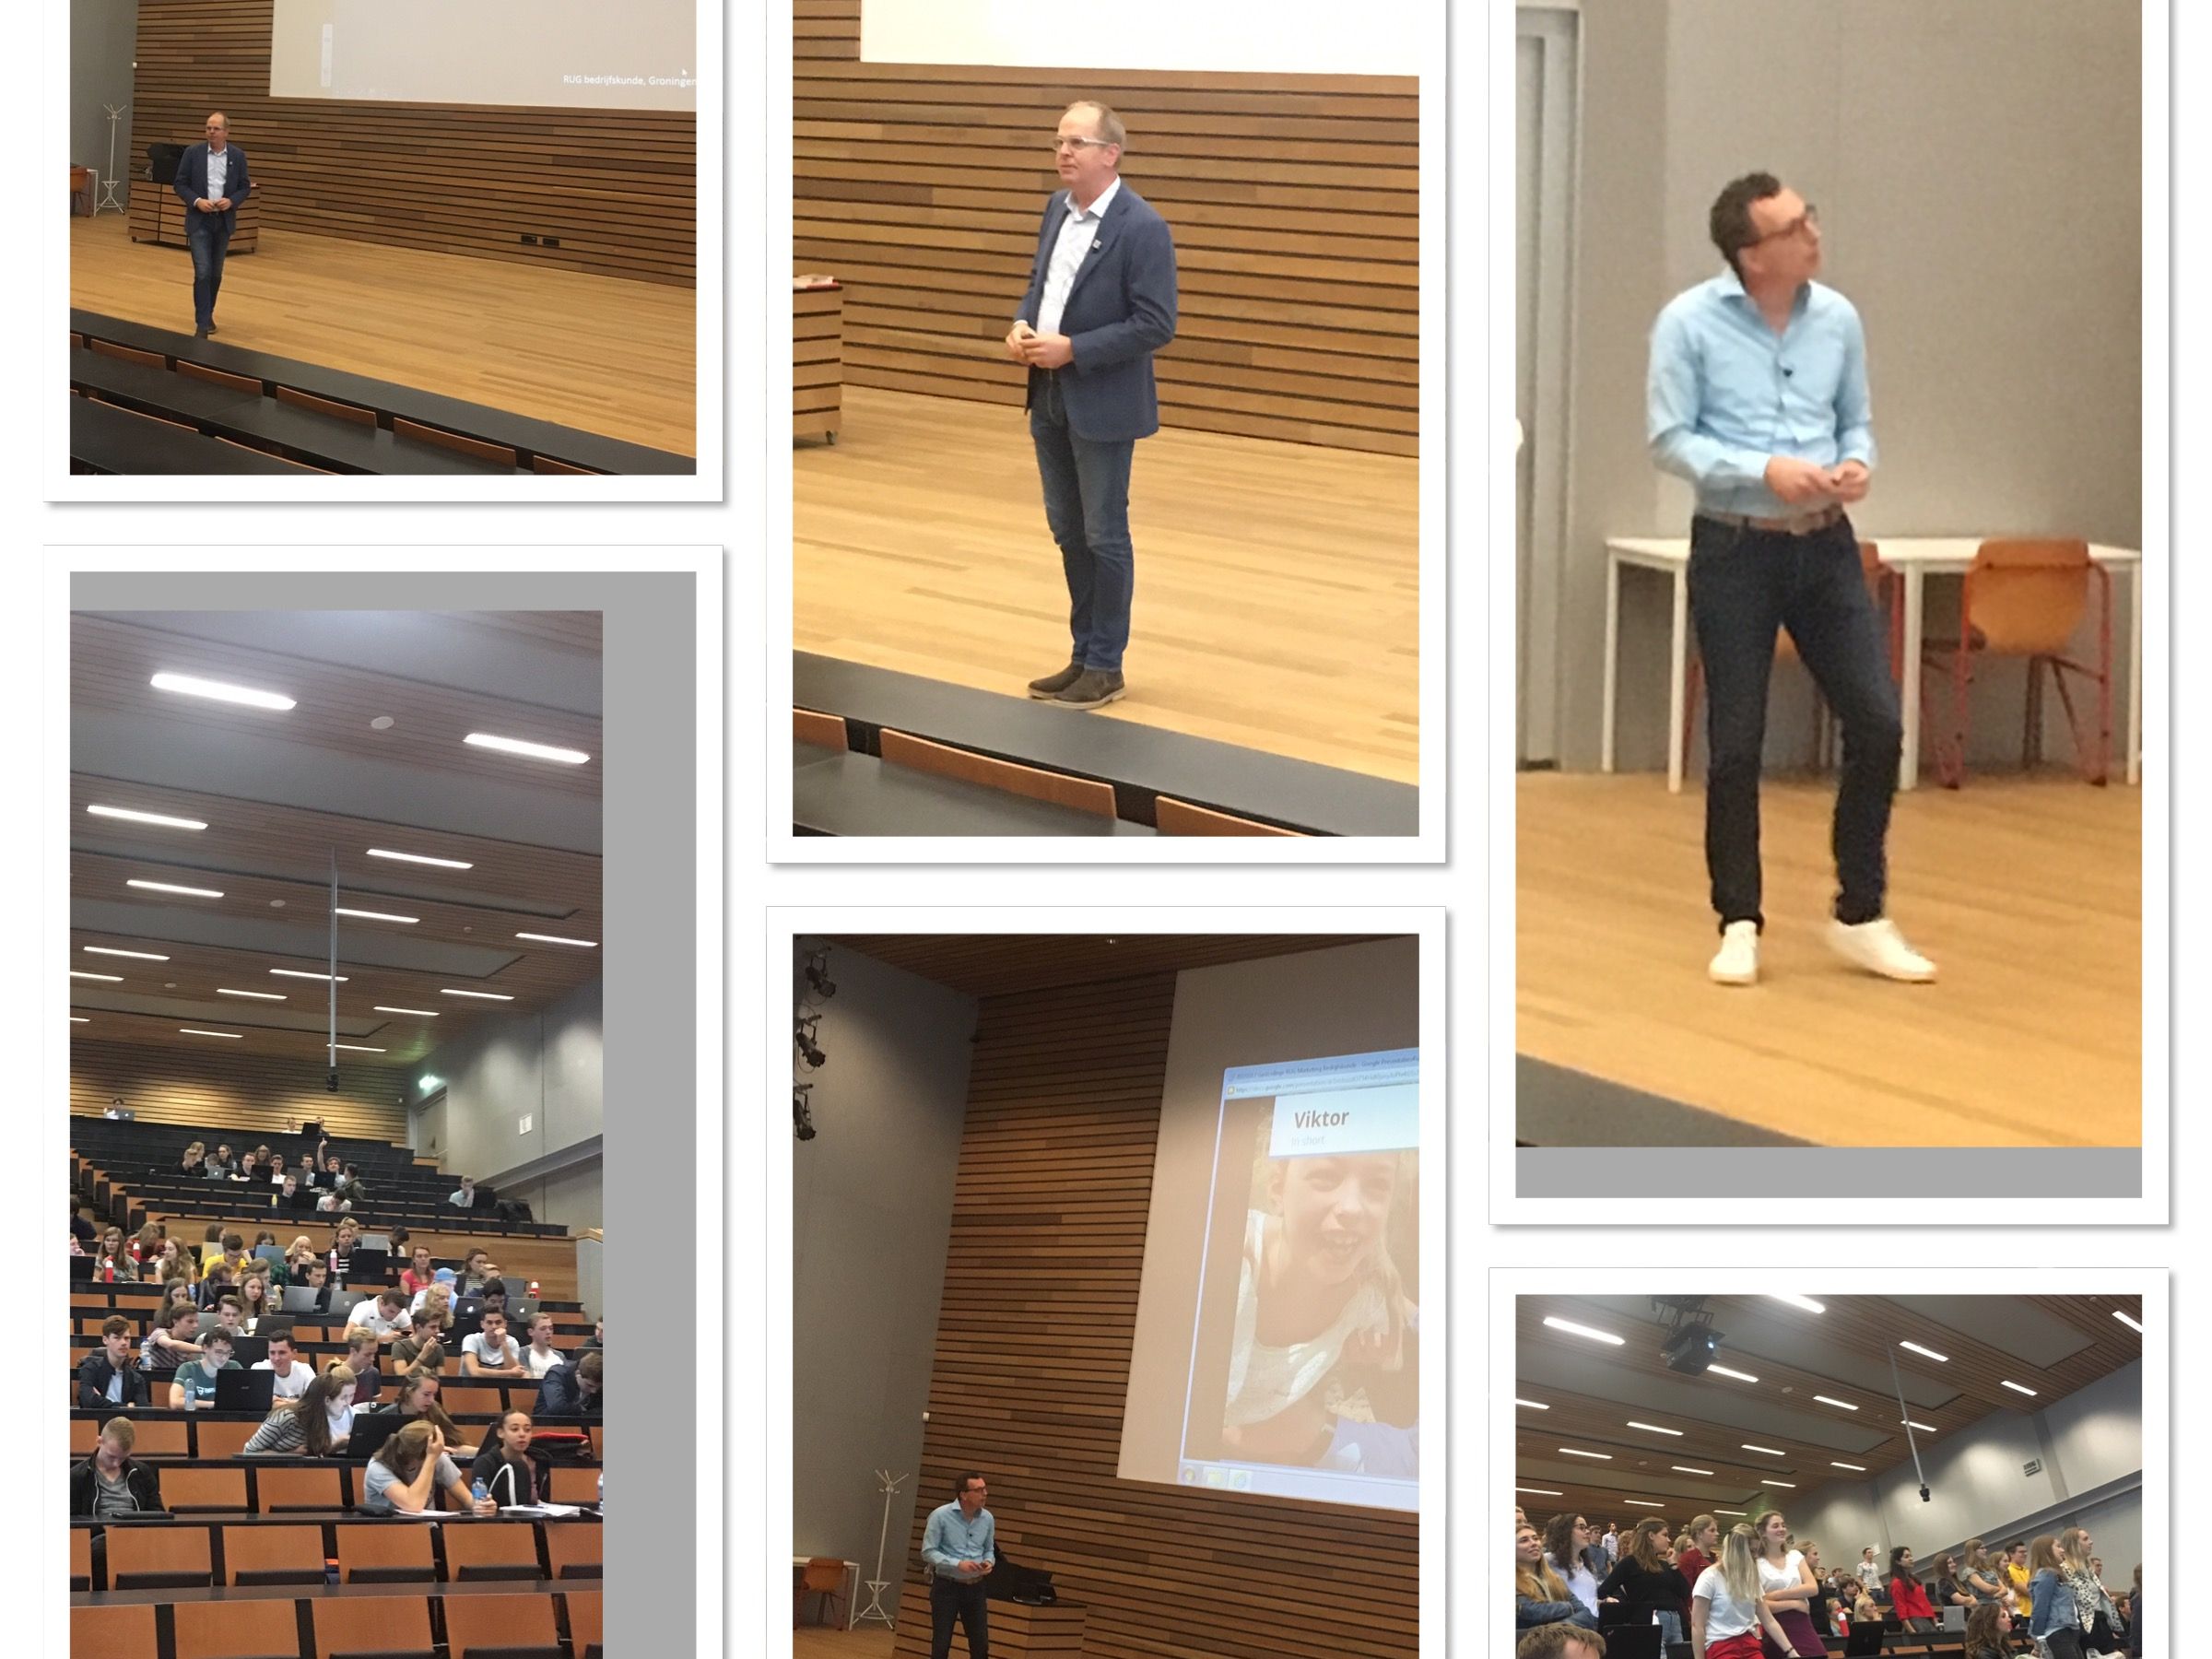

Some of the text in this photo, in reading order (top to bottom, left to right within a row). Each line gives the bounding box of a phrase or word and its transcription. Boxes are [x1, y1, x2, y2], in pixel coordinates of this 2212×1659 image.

[563, 75, 582, 84] RUG
[584, 75, 646, 87] bedrijfskunde,
[1294, 1110, 1349, 1129] Viktor
[1301, 1135, 1324, 1147] short
